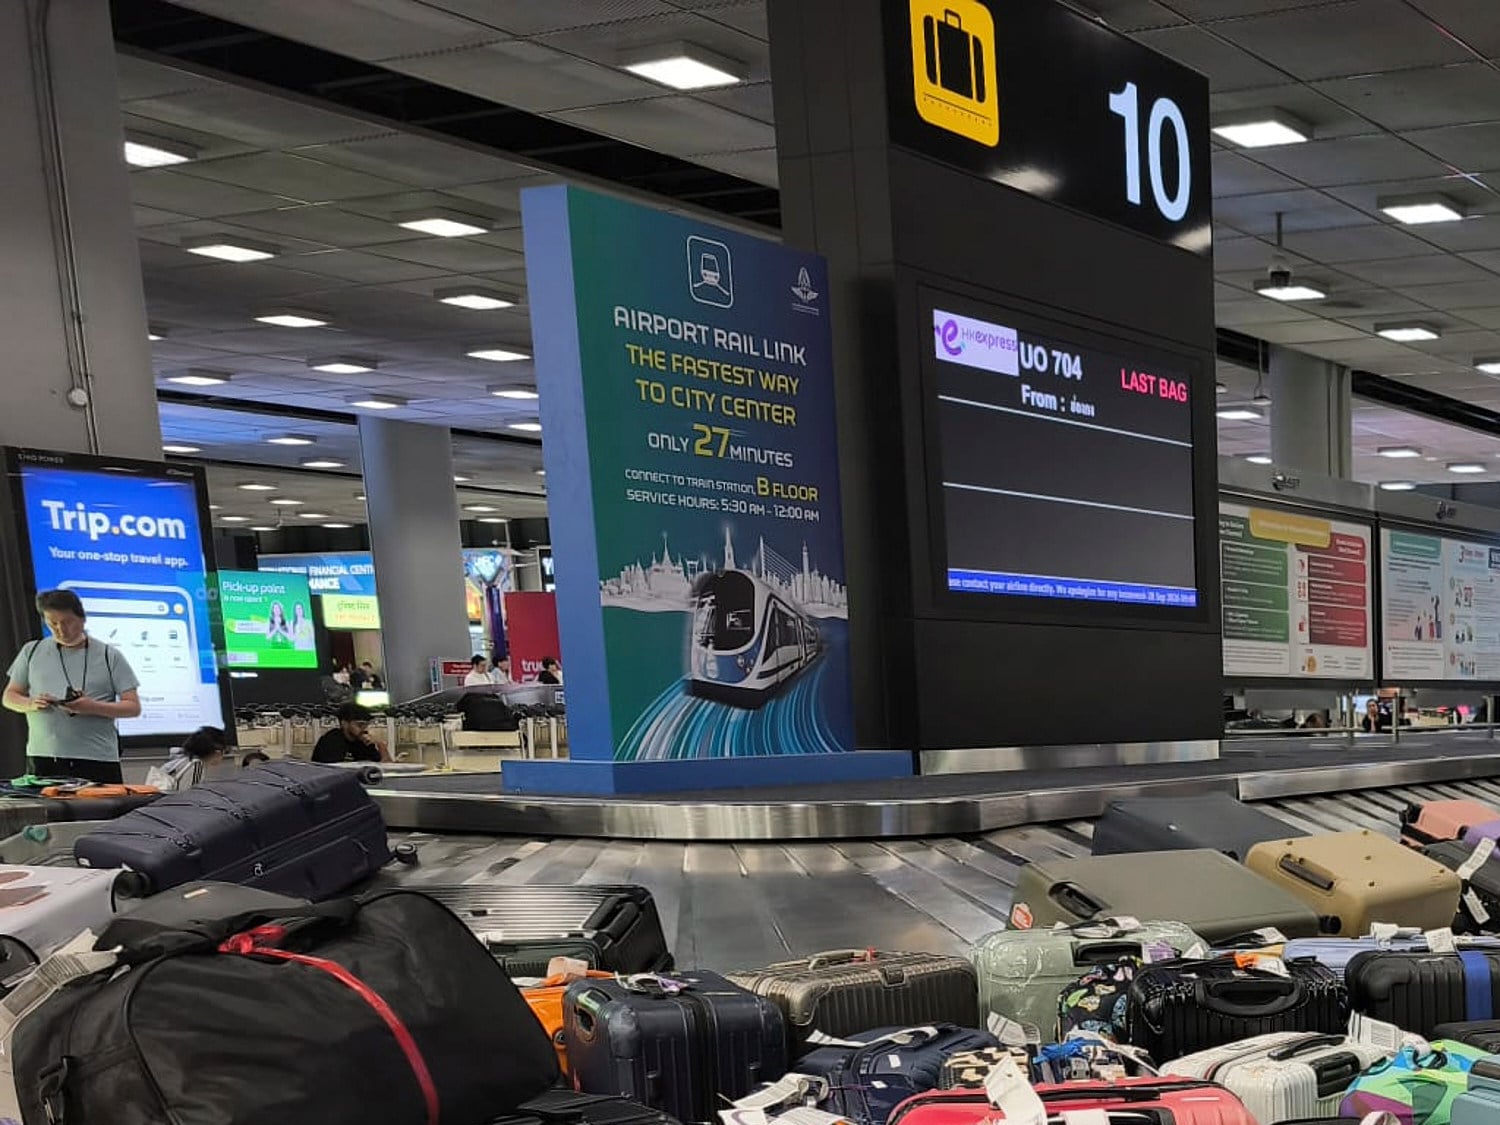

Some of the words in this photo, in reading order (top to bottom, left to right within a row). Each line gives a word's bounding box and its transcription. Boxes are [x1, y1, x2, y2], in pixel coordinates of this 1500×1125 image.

[1107, 81, 1192, 222] 10
[613, 305, 710, 346] AIRPORT
[714, 328, 761, 357] RAIL
[763, 340, 808, 366] LINK
[625, 343, 666, 371] THE
[671, 354, 756, 388] FASTEST
[758, 370, 800, 396] WAY
[1020, 340, 1048, 372] UO
[1051, 349, 1083, 381] 704
[1120, 368, 1156, 394] LAST
[1159, 377, 1188, 402] BAG
[635, 379, 666, 402] TO
[671, 386, 716, 415] CITY
[720, 396, 797, 427] CENTER
[1021, 384, 1057, 412] From
[647, 431, 690, 454] ONLY
[692, 423, 731, 458] 27
[729, 446, 794, 468] MINUTES
[624, 468, 671, 484] CONNECT
[672, 475, 686, 487] TO
[686, 477, 714, 490] TRAIN
[756, 477, 770, 496] B
[772, 483, 819, 502] FLOOR
[40, 499, 187, 541] Trip.com
[625, 488, 677, 506] SERVICE
[678, 494, 720, 511] HOURS:
[721, 499, 747, 514] 5:30
[749, 503, 766, 517] AM
[773, 504, 803, 520] 12:00
[803, 509, 820, 522] AM
[48, 546, 76, 560] Your
[77, 549, 129, 565] one-stop
[130, 552, 163, 565] travel
[164, 556, 189, 568] app.
[308, 564, 349, 576] FINANCIAL
[222, 580, 259, 594] Pick-up
[260, 584, 286, 595] point
[521, 660, 544, 673] tru
